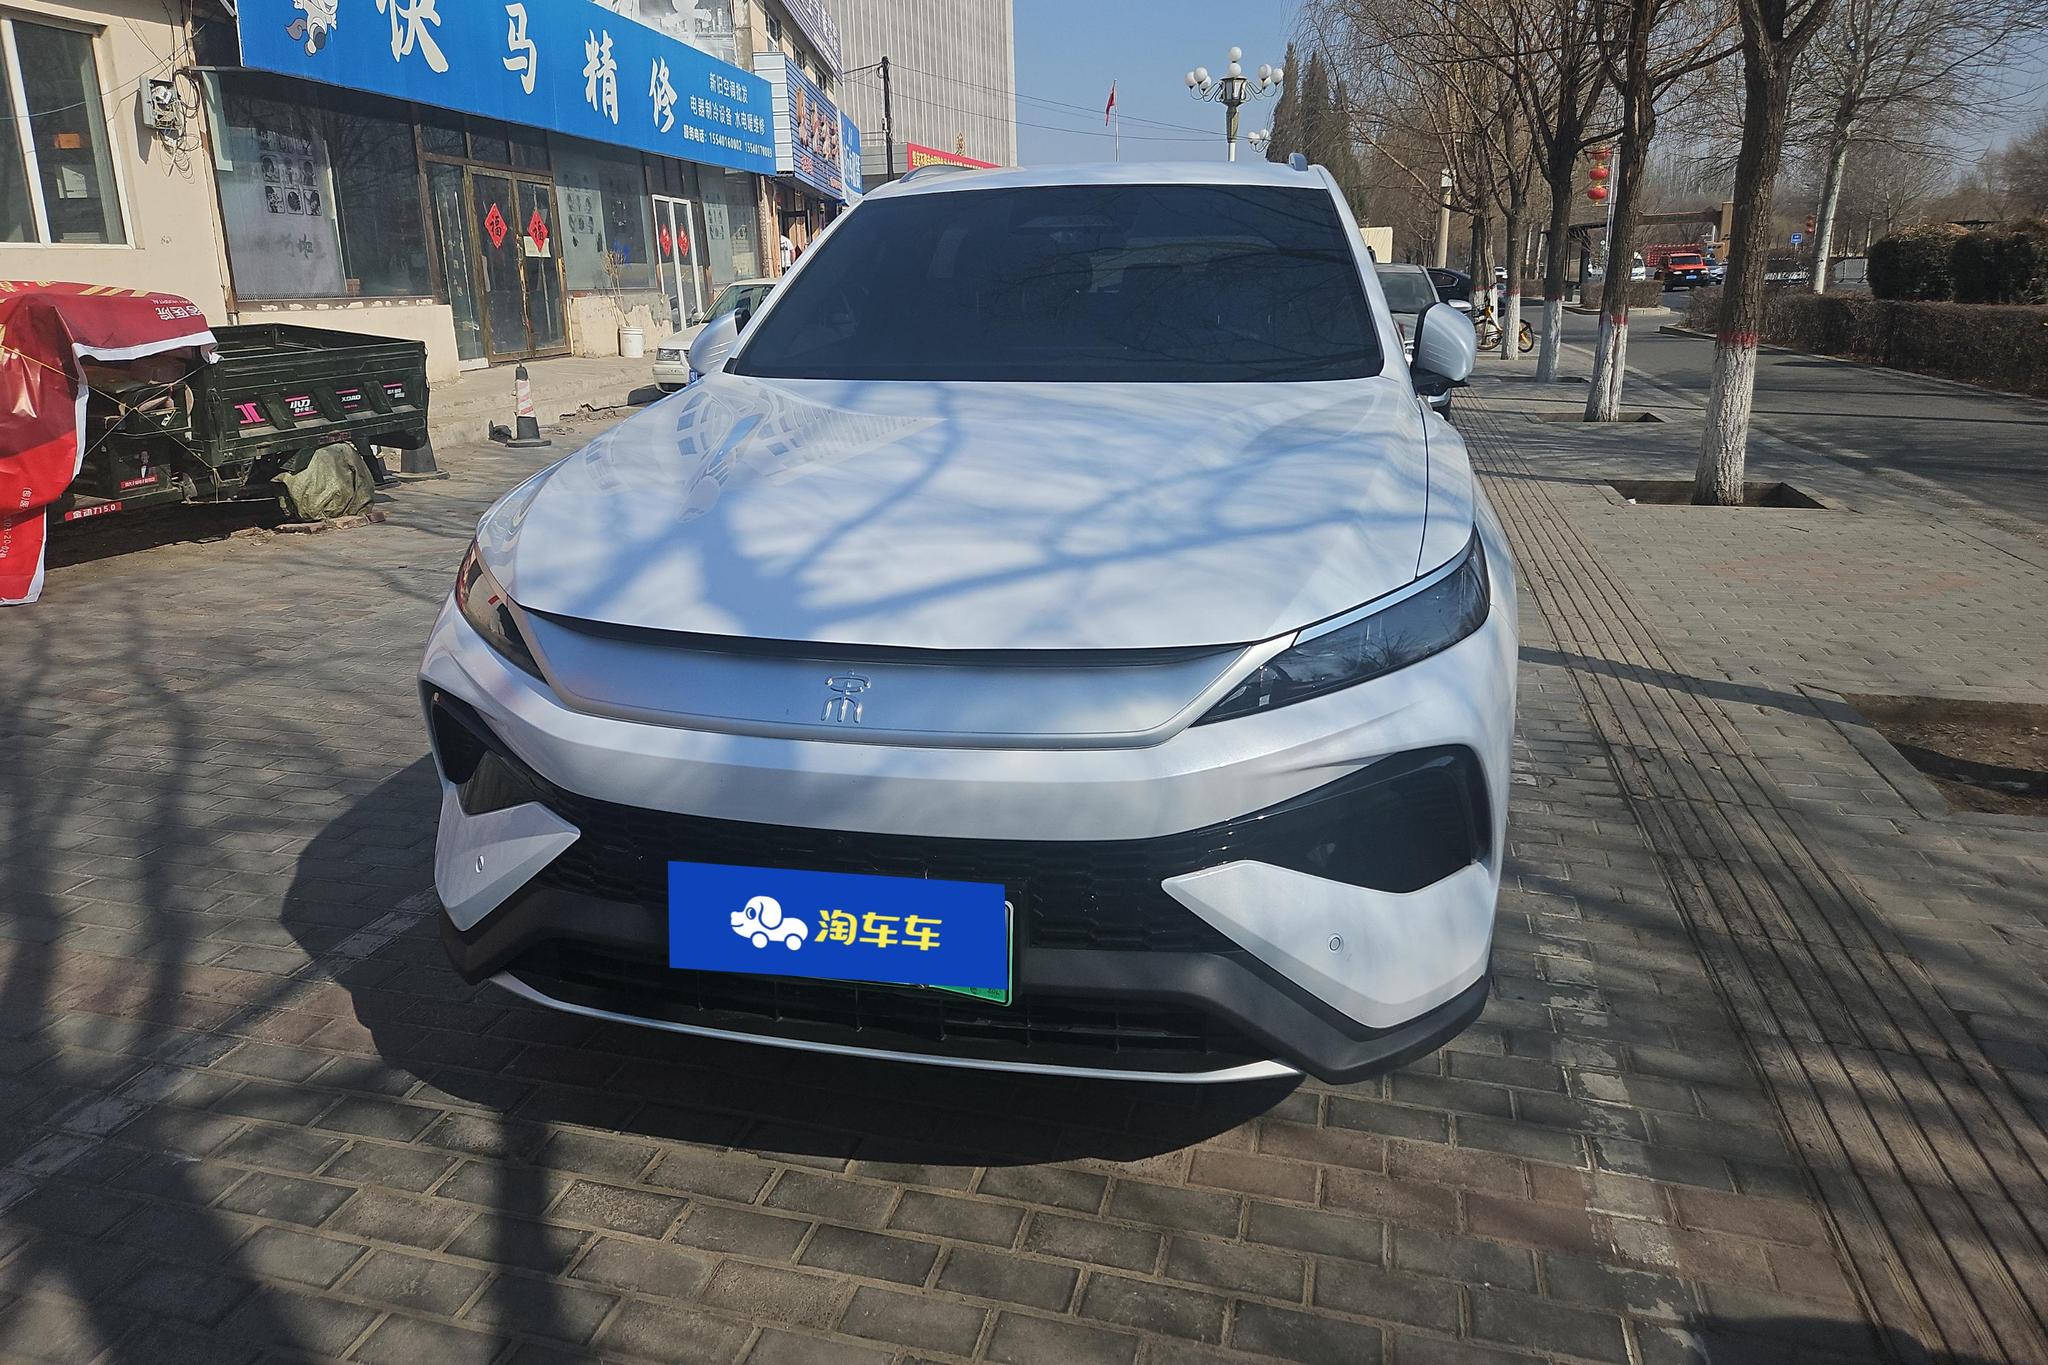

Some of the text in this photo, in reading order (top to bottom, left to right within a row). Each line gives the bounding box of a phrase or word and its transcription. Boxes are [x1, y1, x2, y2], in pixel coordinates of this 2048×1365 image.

[376, 0, 677, 133] 快马精修
[708, 72, 748, 104] 新旧空调批发
[689, 94, 765, 135] 电器制冷设备 水电暖维修
